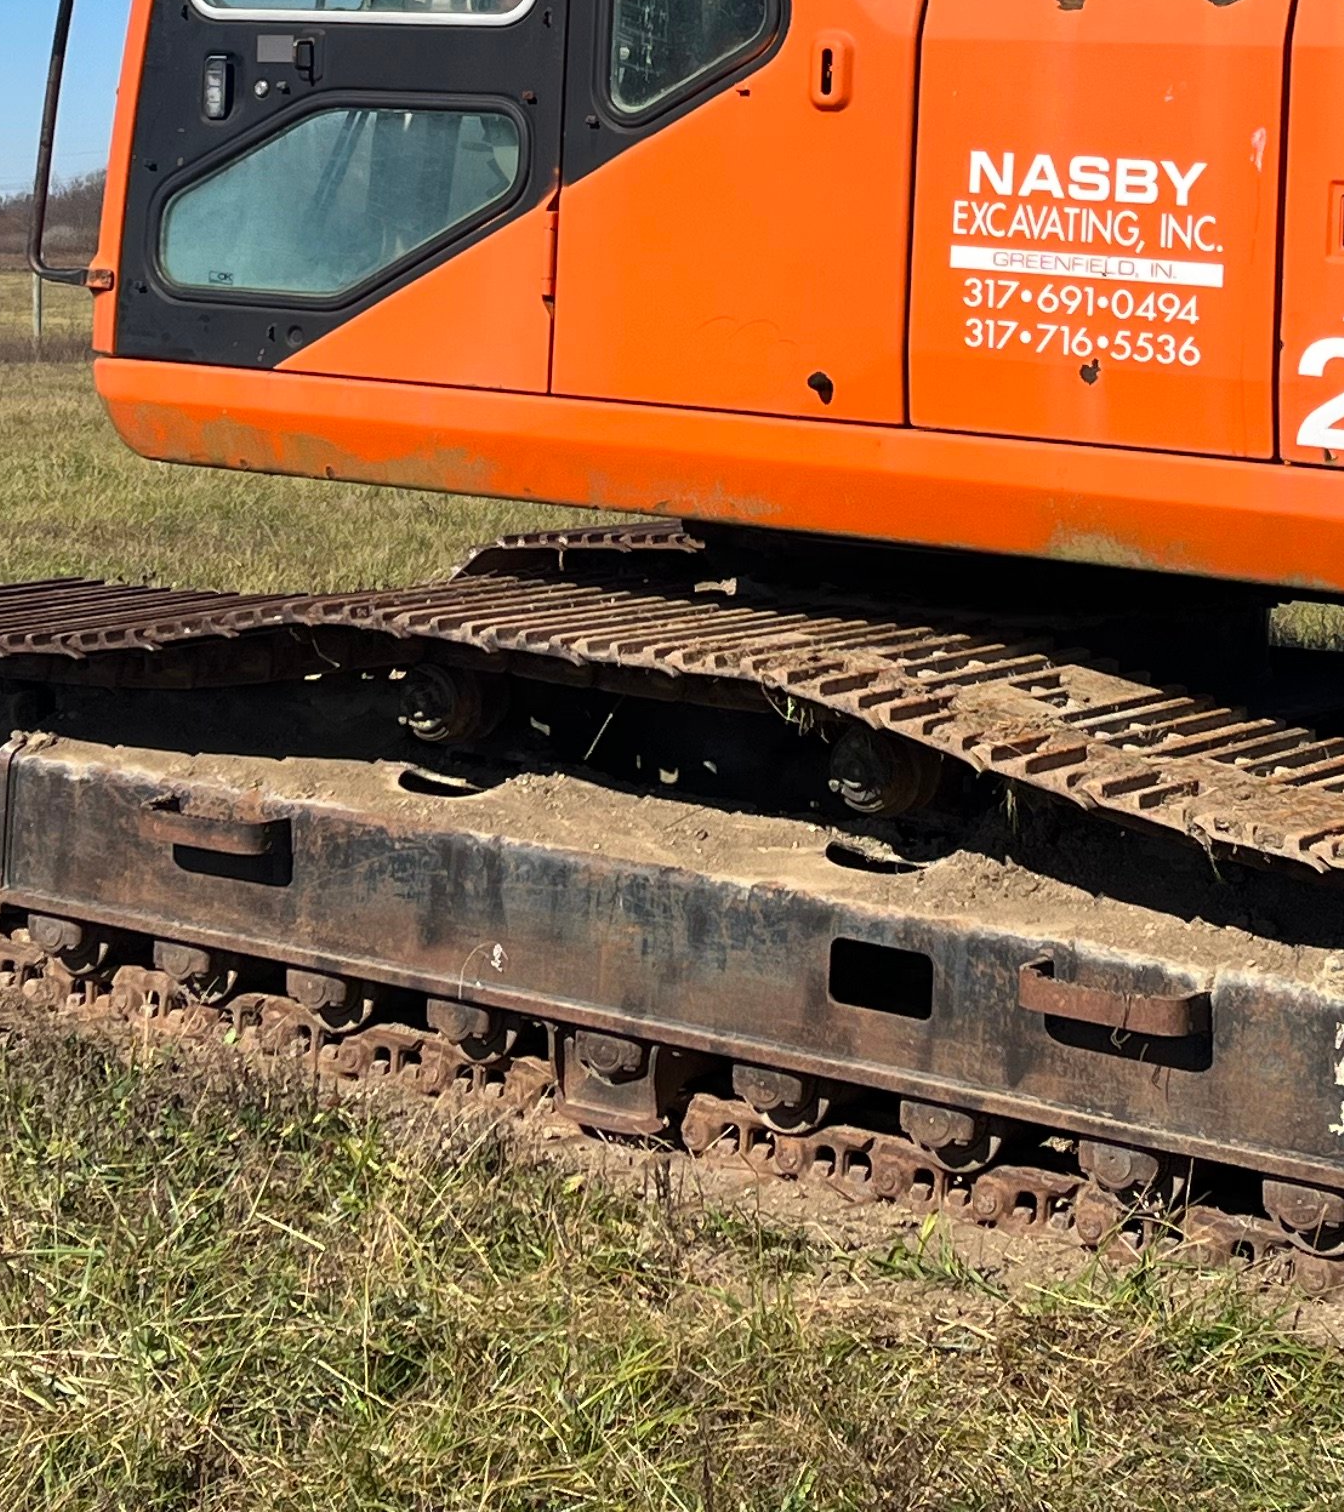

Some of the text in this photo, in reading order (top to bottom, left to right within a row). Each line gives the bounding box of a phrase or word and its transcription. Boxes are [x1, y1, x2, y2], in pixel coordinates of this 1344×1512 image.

[968, 150, 1207, 207] NASBY
[953, 199, 1223, 254] EXCAVATING, INC.
[991, 251, 1178, 280] GREENFIELD, IN.
